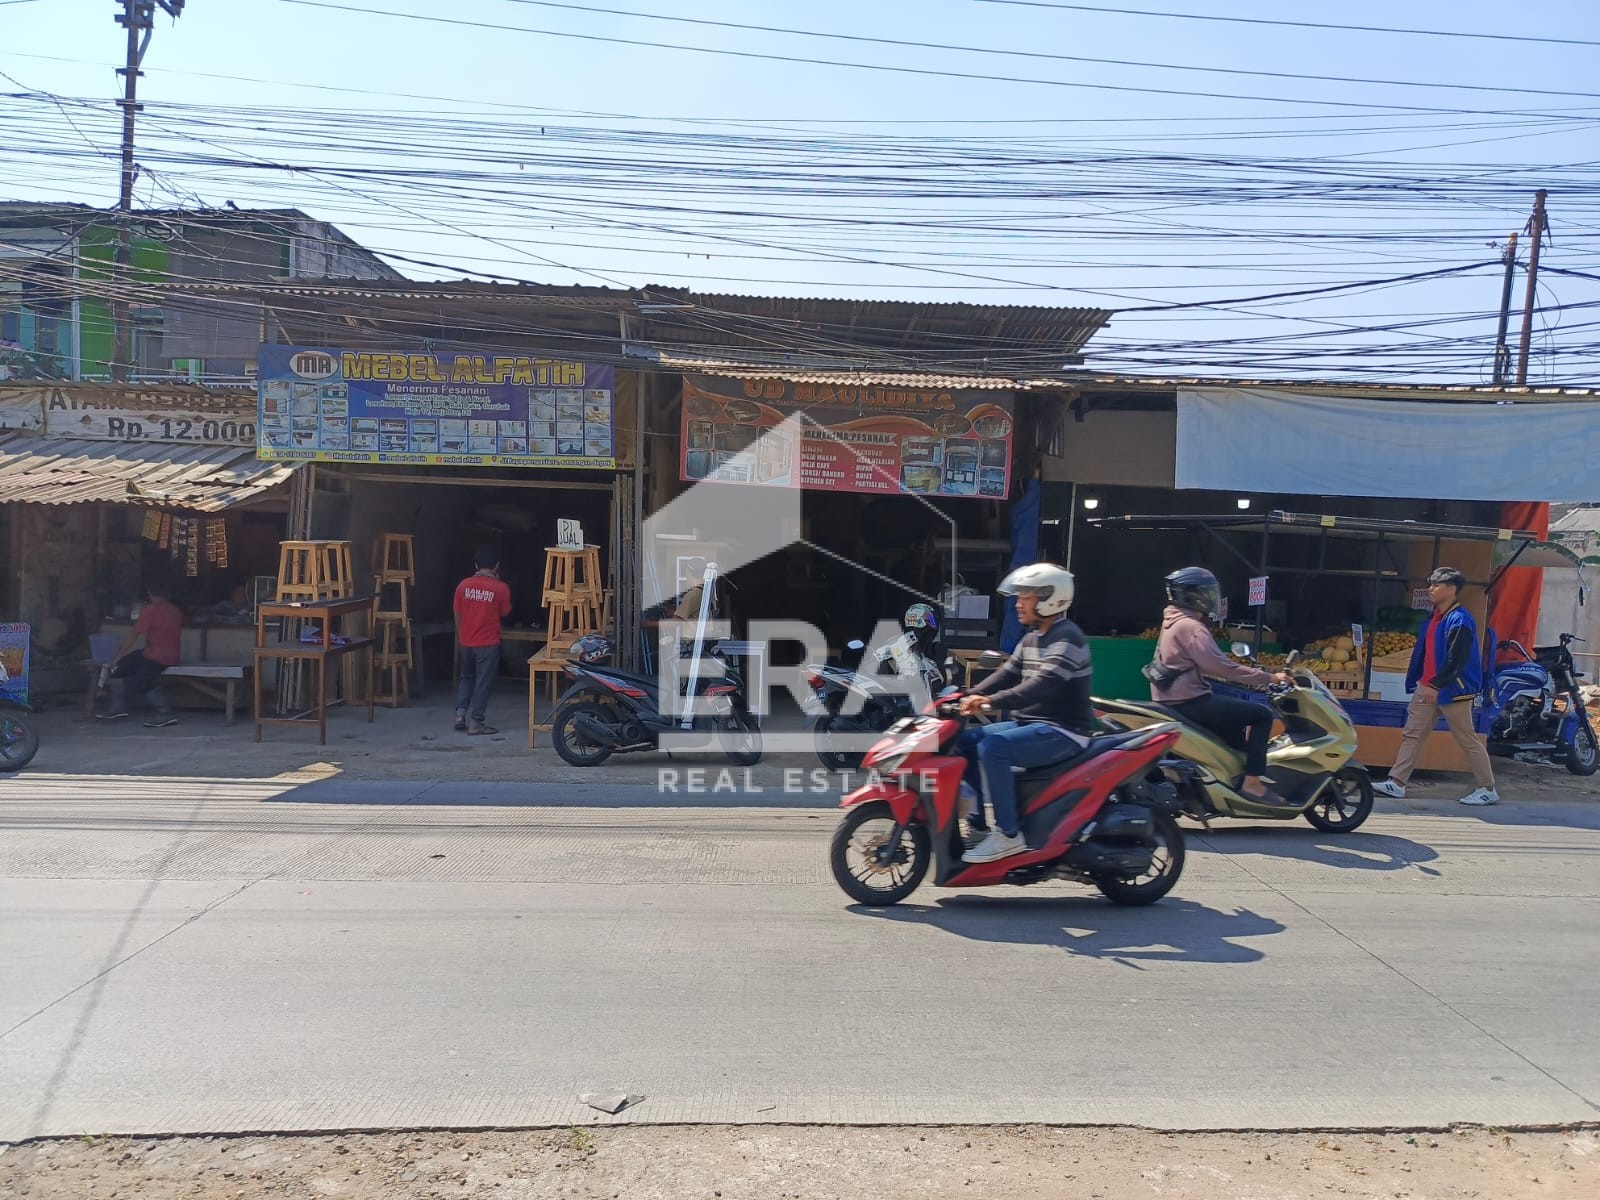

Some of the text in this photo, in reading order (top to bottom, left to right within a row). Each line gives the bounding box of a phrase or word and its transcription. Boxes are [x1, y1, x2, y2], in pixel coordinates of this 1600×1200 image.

[297, 356, 331, 374] MA
[342, 351, 585, 386] MEBEL ALFATIH
[387, 384, 489, 395] Menerima Pesanan:
[108, 417, 256, 442] Rp. 12.000
[852, 432, 891, 443] PESANAN
[560, 531, 580, 545] JUAL
